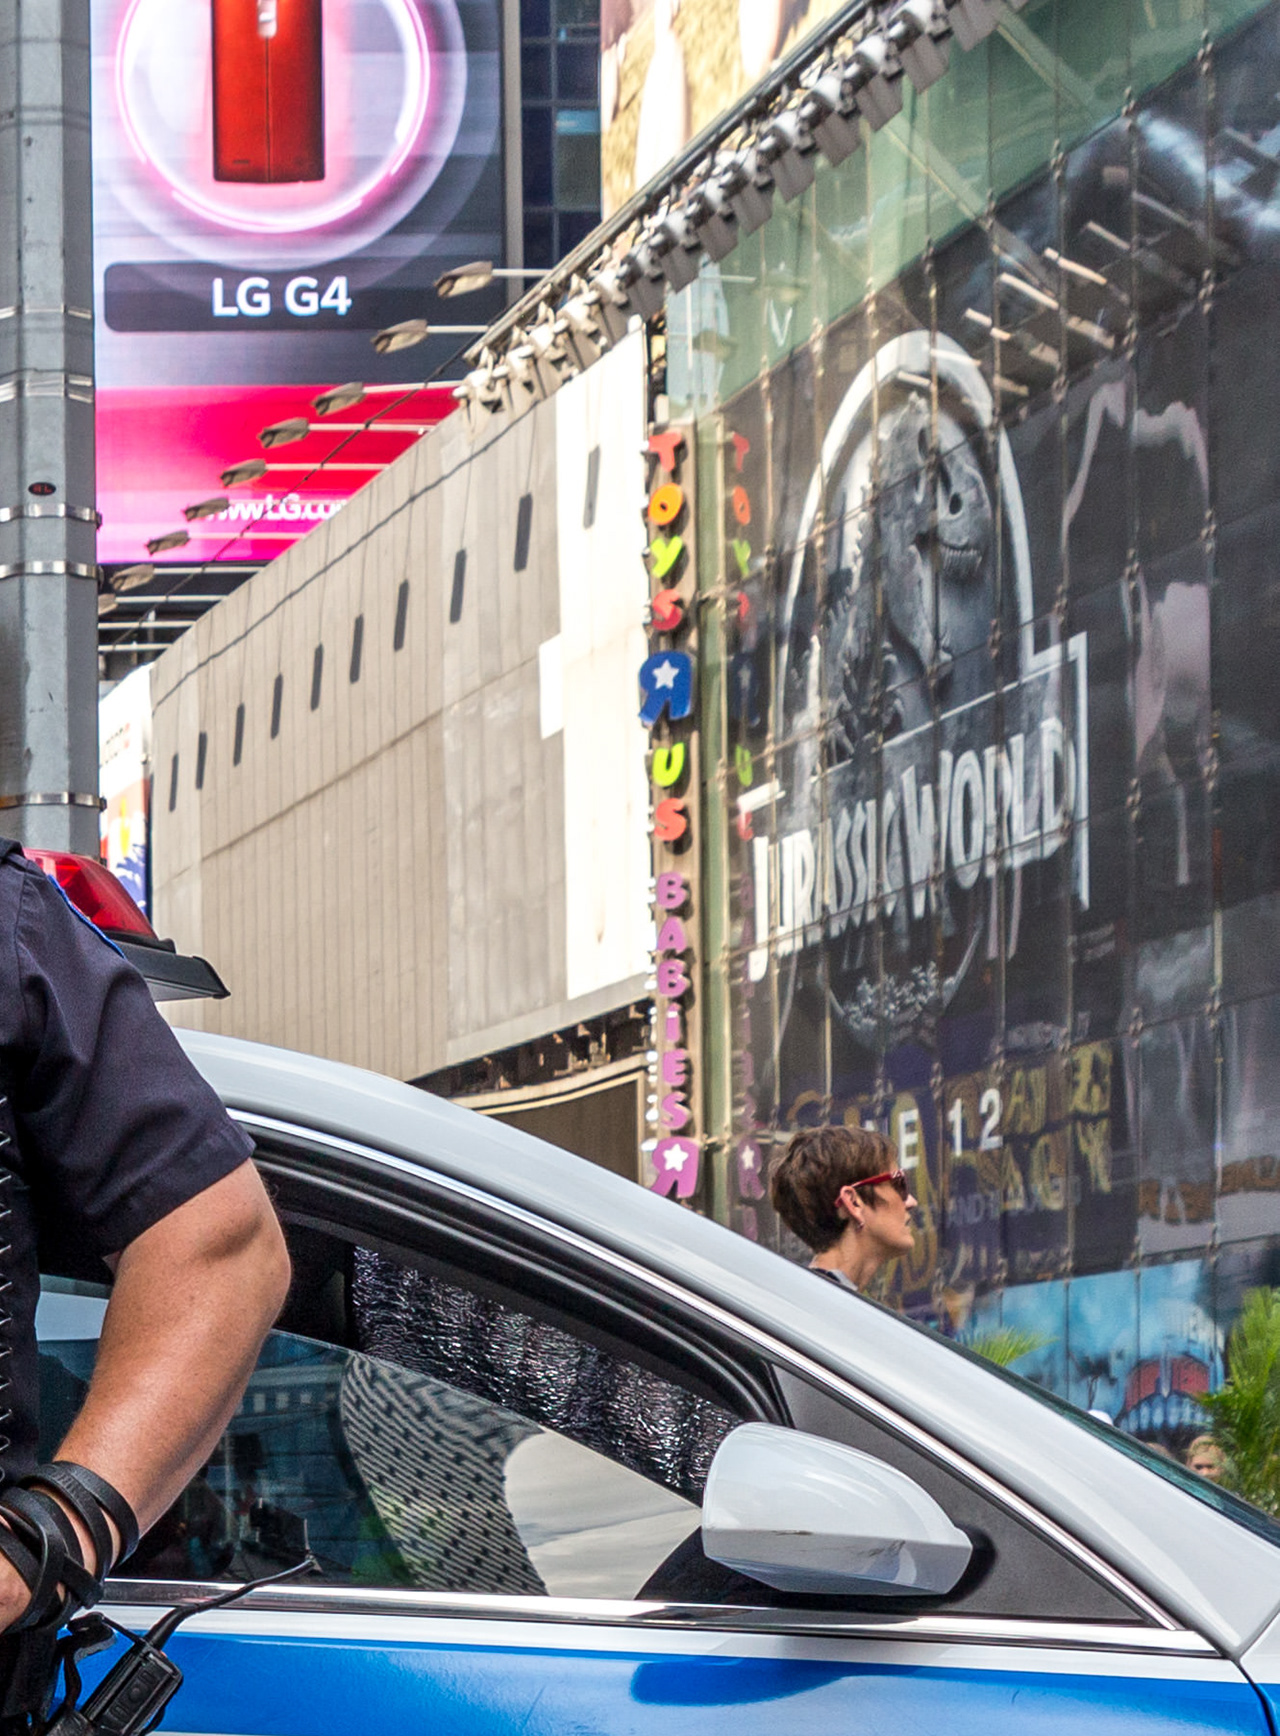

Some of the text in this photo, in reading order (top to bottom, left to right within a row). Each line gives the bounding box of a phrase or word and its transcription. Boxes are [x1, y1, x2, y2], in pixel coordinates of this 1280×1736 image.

[211, 276, 352, 317] LG G4
[648, 431, 684, 631] TOYS
[652, 742, 687, 842] US
[656, 872, 691, 1129] BABIES
